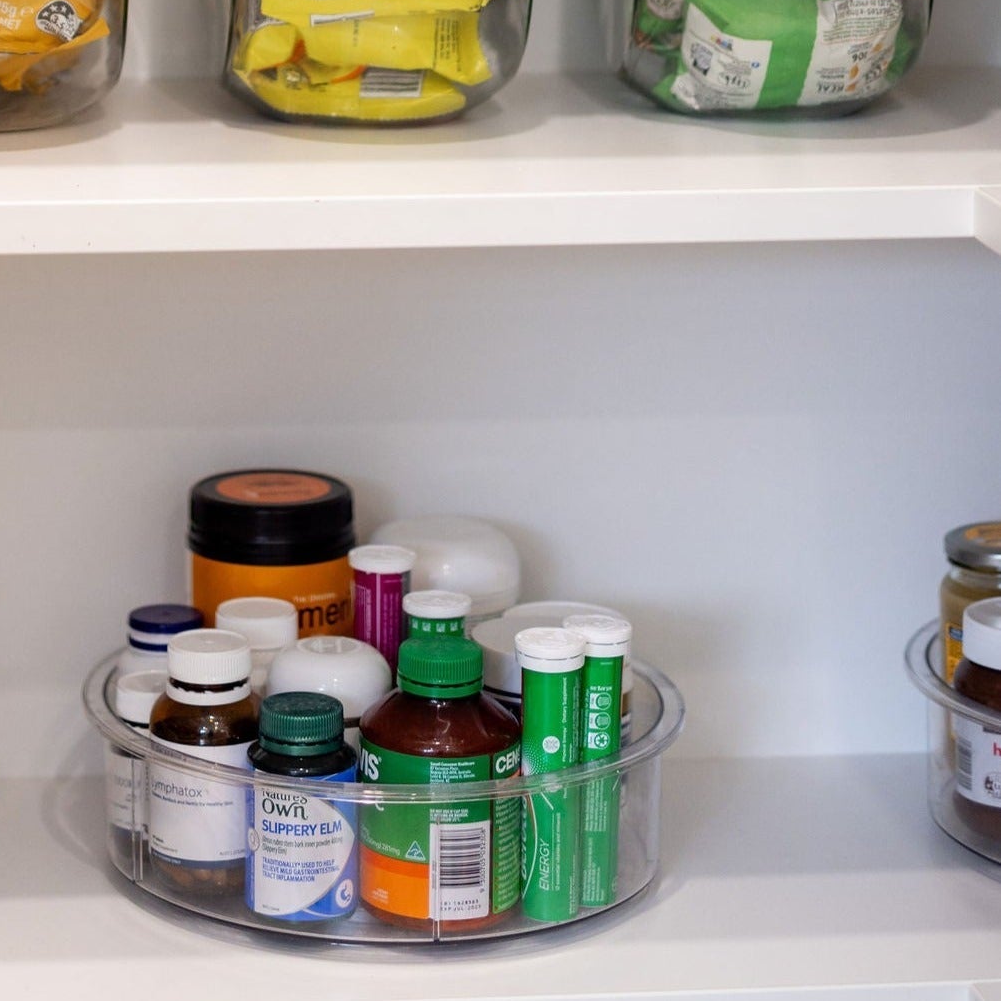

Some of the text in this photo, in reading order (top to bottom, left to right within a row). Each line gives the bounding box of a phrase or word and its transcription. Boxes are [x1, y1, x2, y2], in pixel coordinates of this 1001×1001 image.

[262, 798, 309, 820] Own
[262, 819, 342, 836] SLIPPERY ELM
[539, 837, 550, 891] ENERGY
